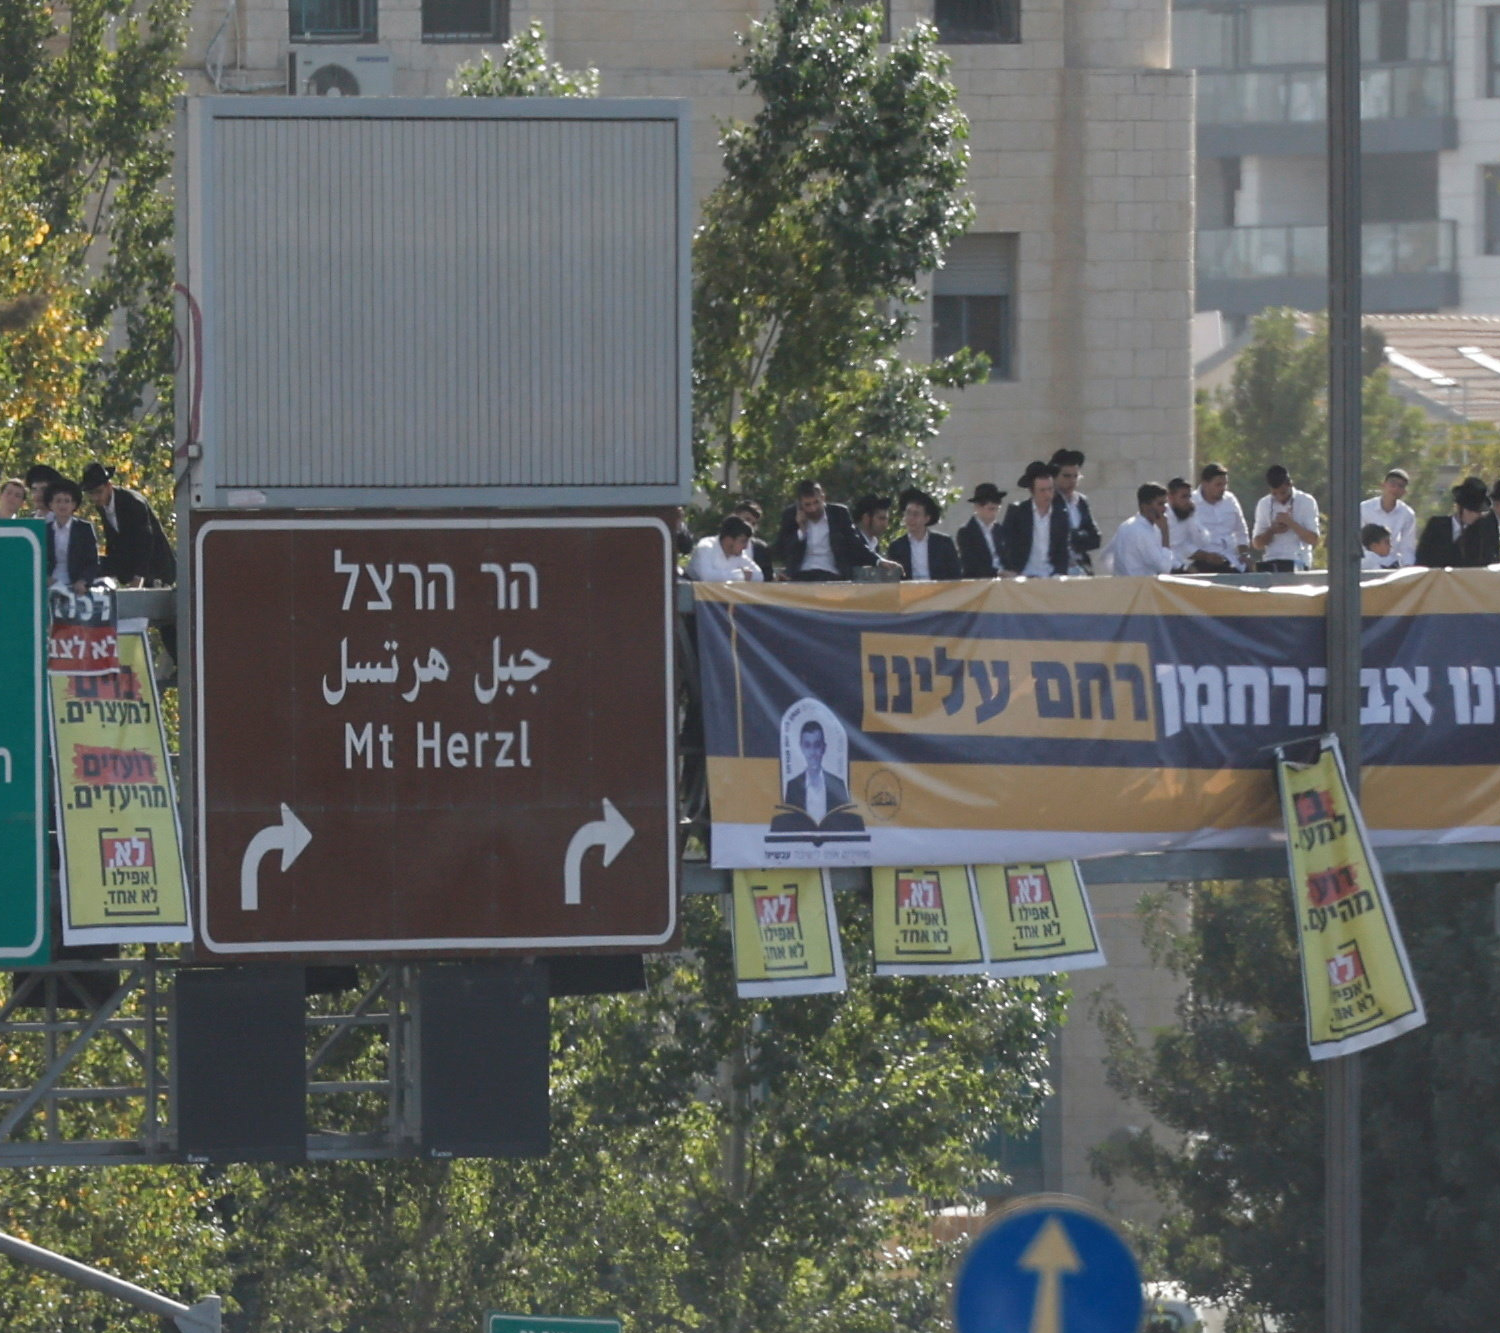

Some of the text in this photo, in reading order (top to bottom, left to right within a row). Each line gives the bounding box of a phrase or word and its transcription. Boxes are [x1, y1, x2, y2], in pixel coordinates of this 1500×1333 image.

[334, 549, 539, 611] הר הרצל
[49, 636, 88, 659] לצב
[322, 635, 552, 706] جبل هرتسل
[868, 645, 1012, 725] עלינו
[1031, 661, 1149, 722] רחם
[60, 701, 150, 728] למעצרים.
[344, 720, 532, 769] Mt Herzl
[82, 752, 155, 778] רועדים
[67, 786, 168, 812] מהיעדים.
[112, 867, 150, 885] אפילו
[104, 887, 158, 905] לא אחד.
[906, 909, 939, 926] אפילו
[1018, 905, 1049, 920] אפילו
[895, 927, 948, 943] לא אחד.
[1042, 922, 1060, 938] לא
